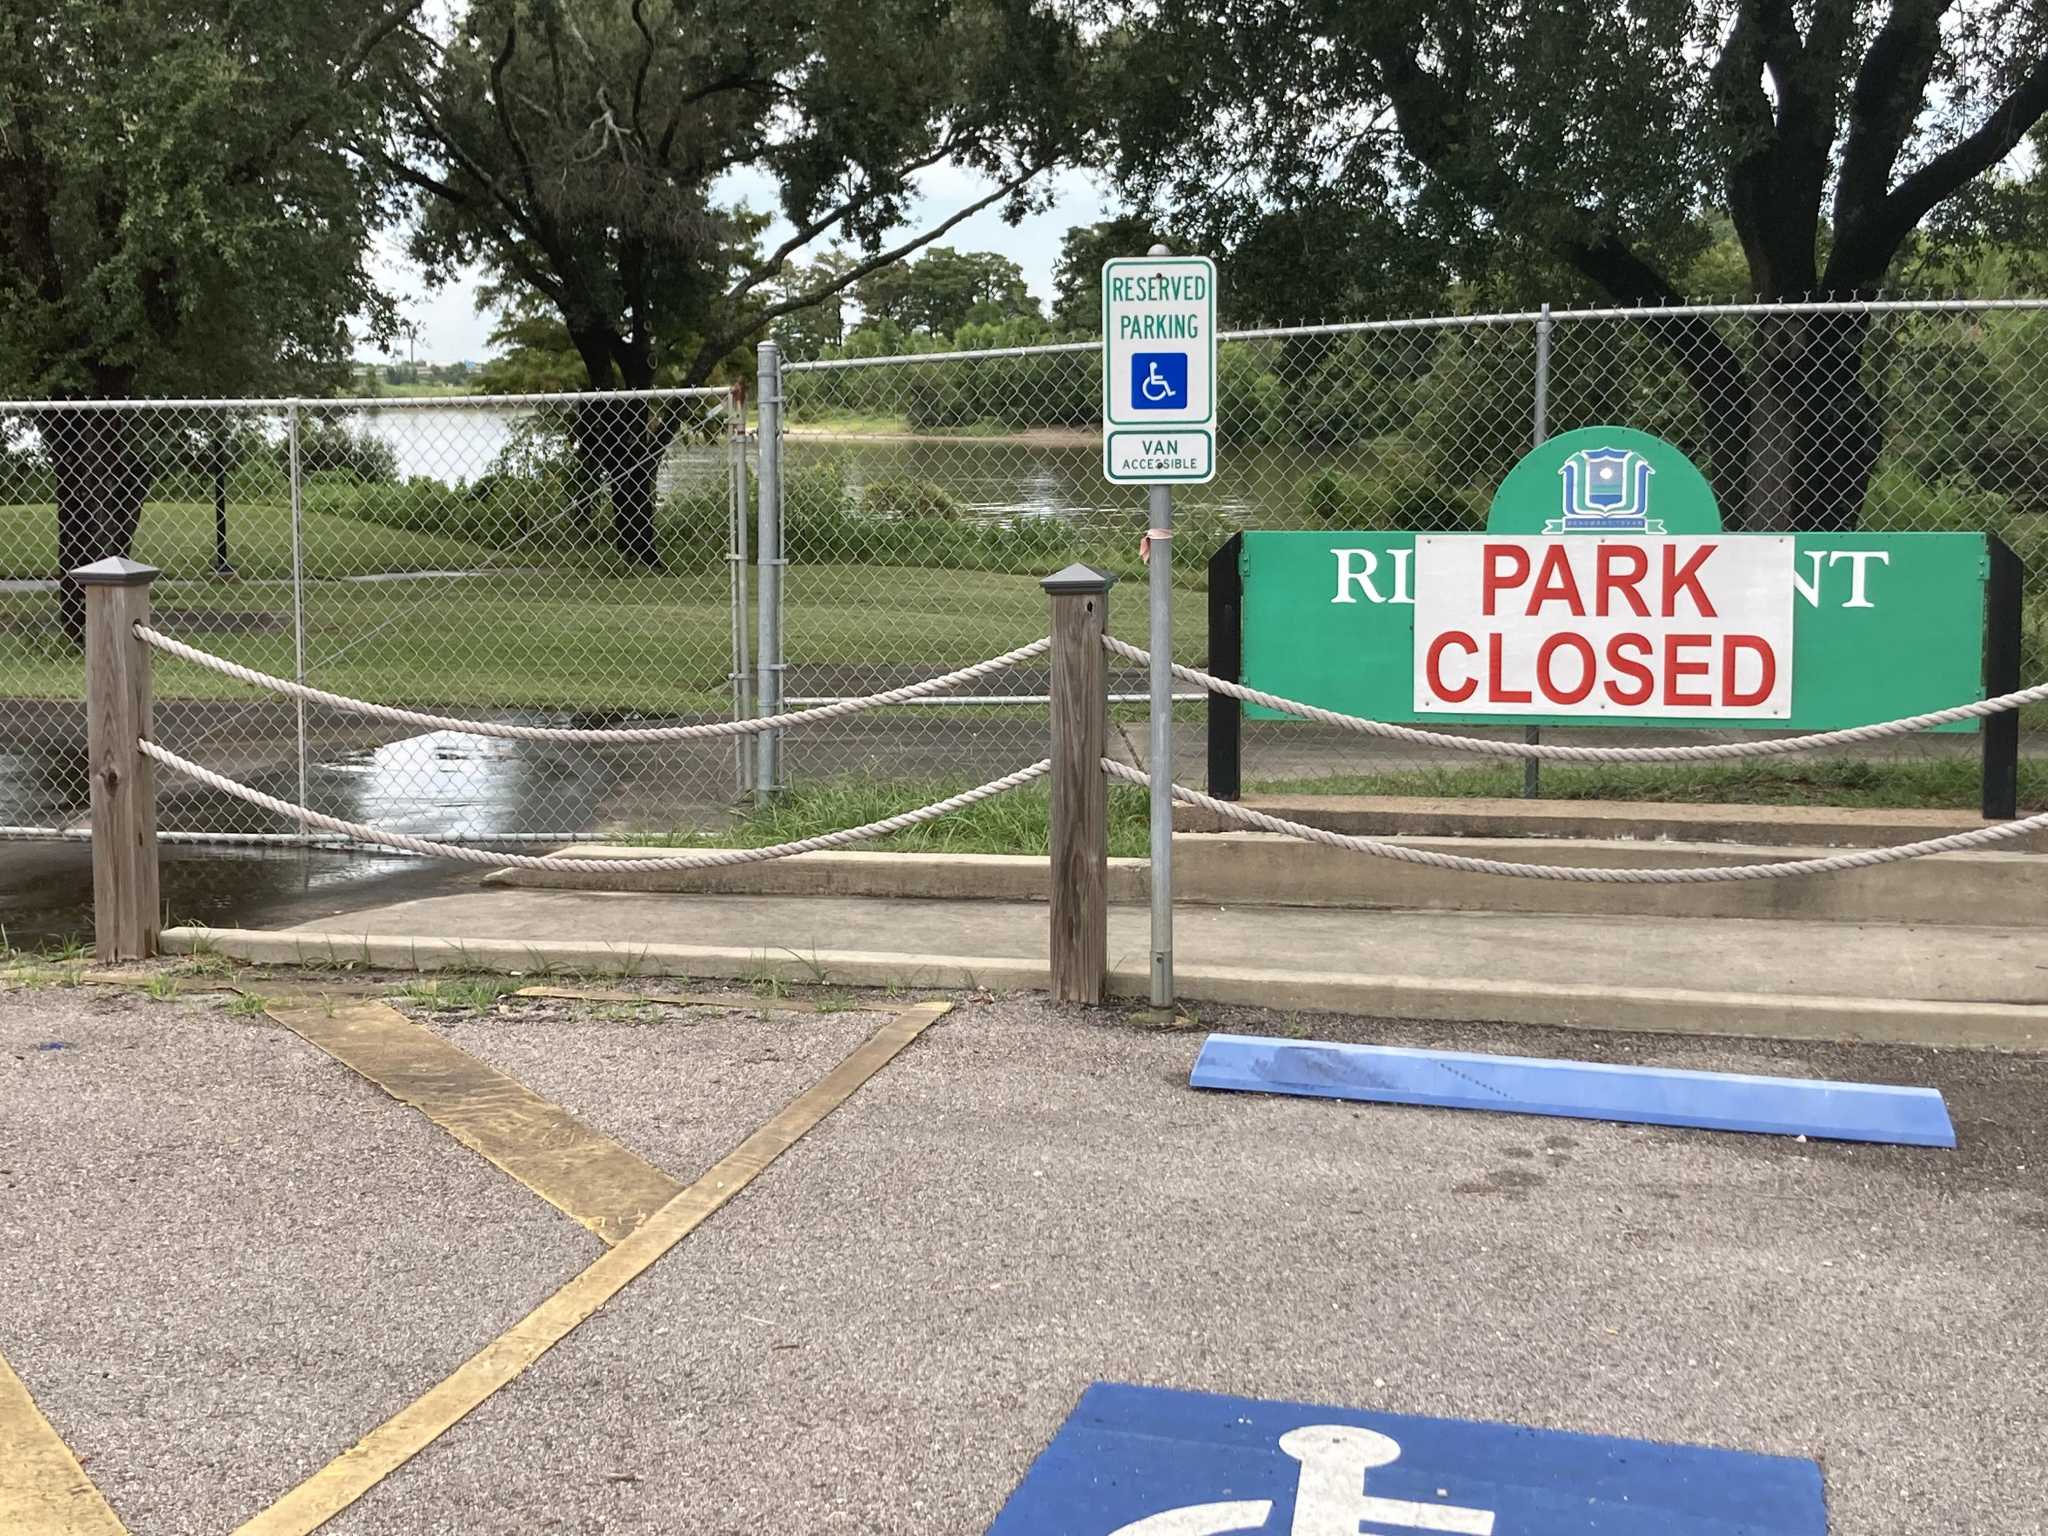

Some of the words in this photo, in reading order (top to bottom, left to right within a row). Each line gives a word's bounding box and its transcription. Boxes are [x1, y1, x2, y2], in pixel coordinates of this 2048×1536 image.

[1112, 276, 1206, 302] RESERVED
[1120, 313, 1198, 340] PARKING
[1142, 439, 1178, 456] VAN
[1481, 544, 1719, 618] PARK
[1426, 630, 1777, 707] CLOSED
